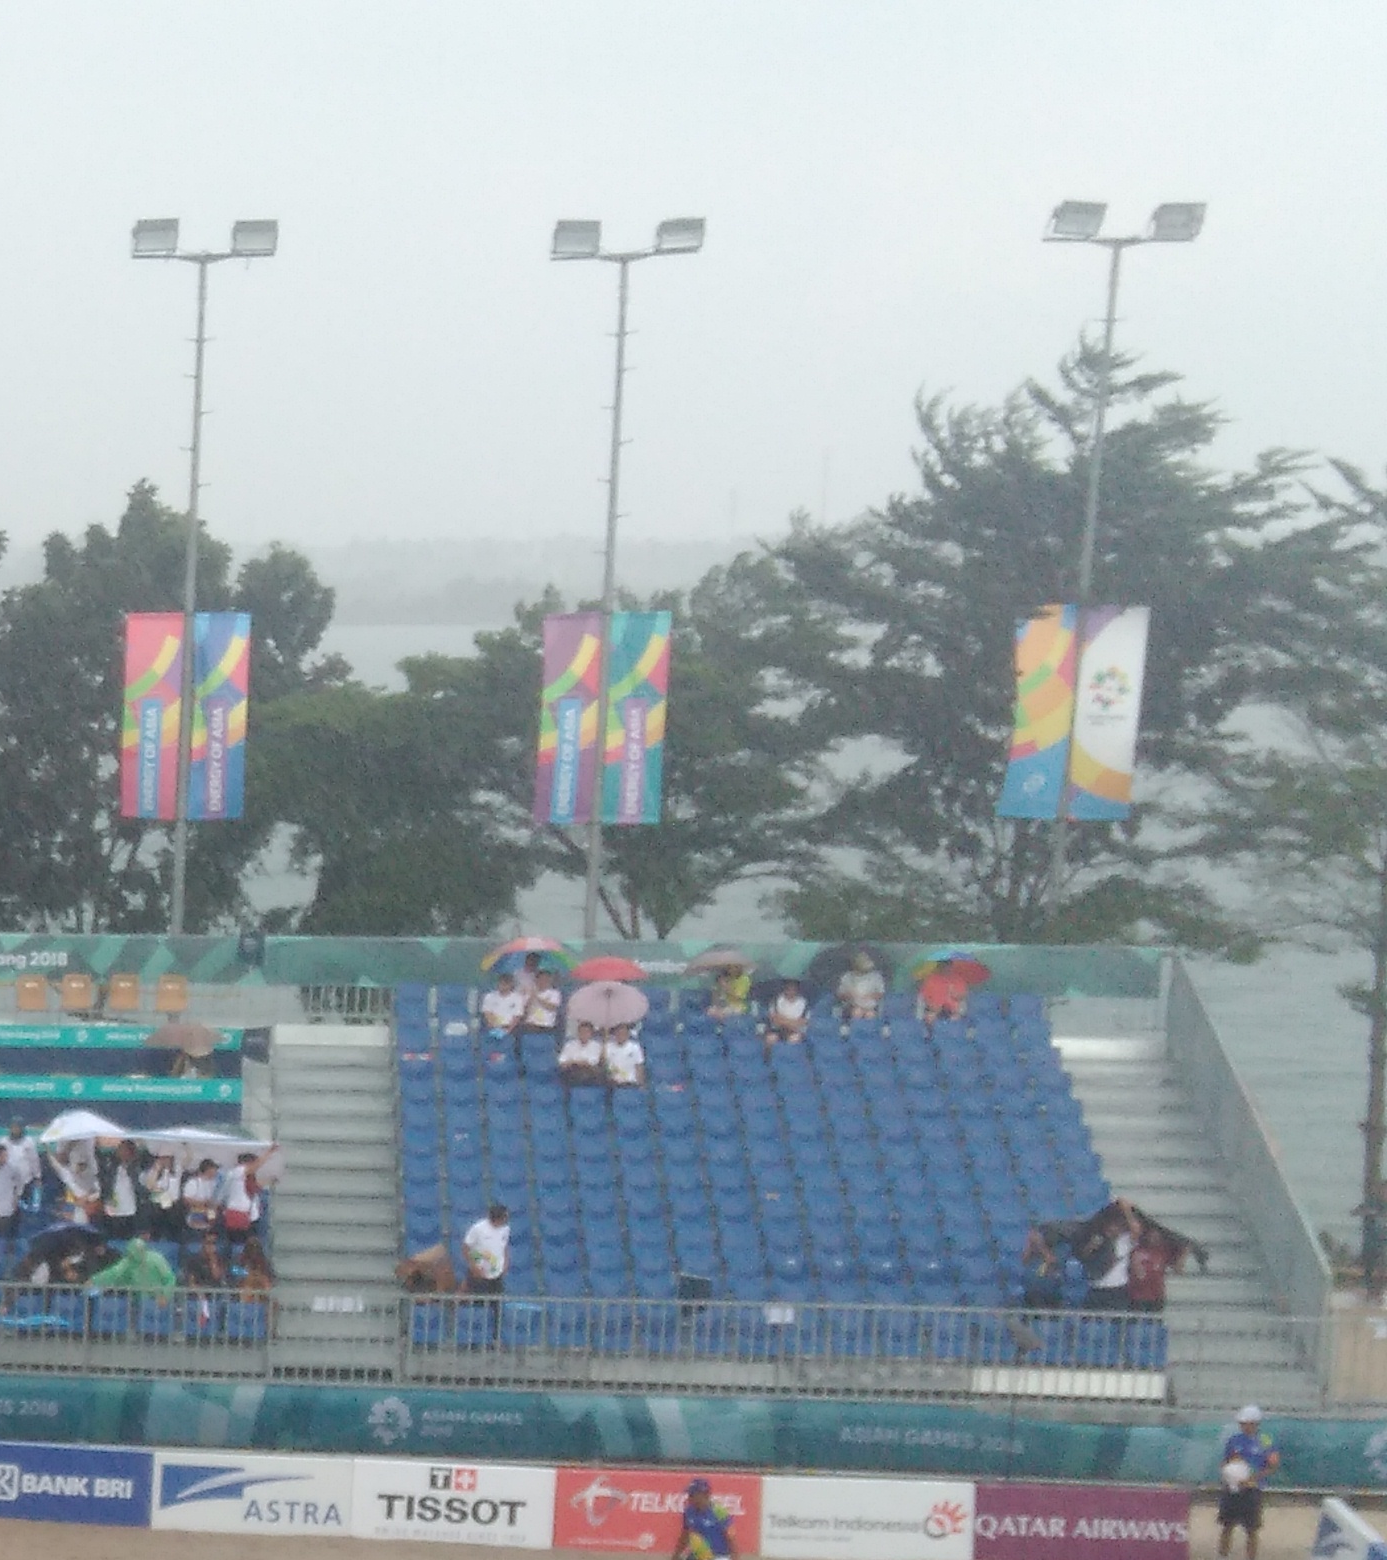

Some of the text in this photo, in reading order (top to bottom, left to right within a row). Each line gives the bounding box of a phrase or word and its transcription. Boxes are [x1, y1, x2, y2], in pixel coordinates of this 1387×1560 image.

[30, 952, 68, 966] 2018
[21, 1475, 131, 1498] BANK BRI
[243, 1500, 341, 1526] ASTRA
[378, 1494, 526, 1526] TISSOT
[975, 1515, 1189, 1542] QATAR AIRWAYS
